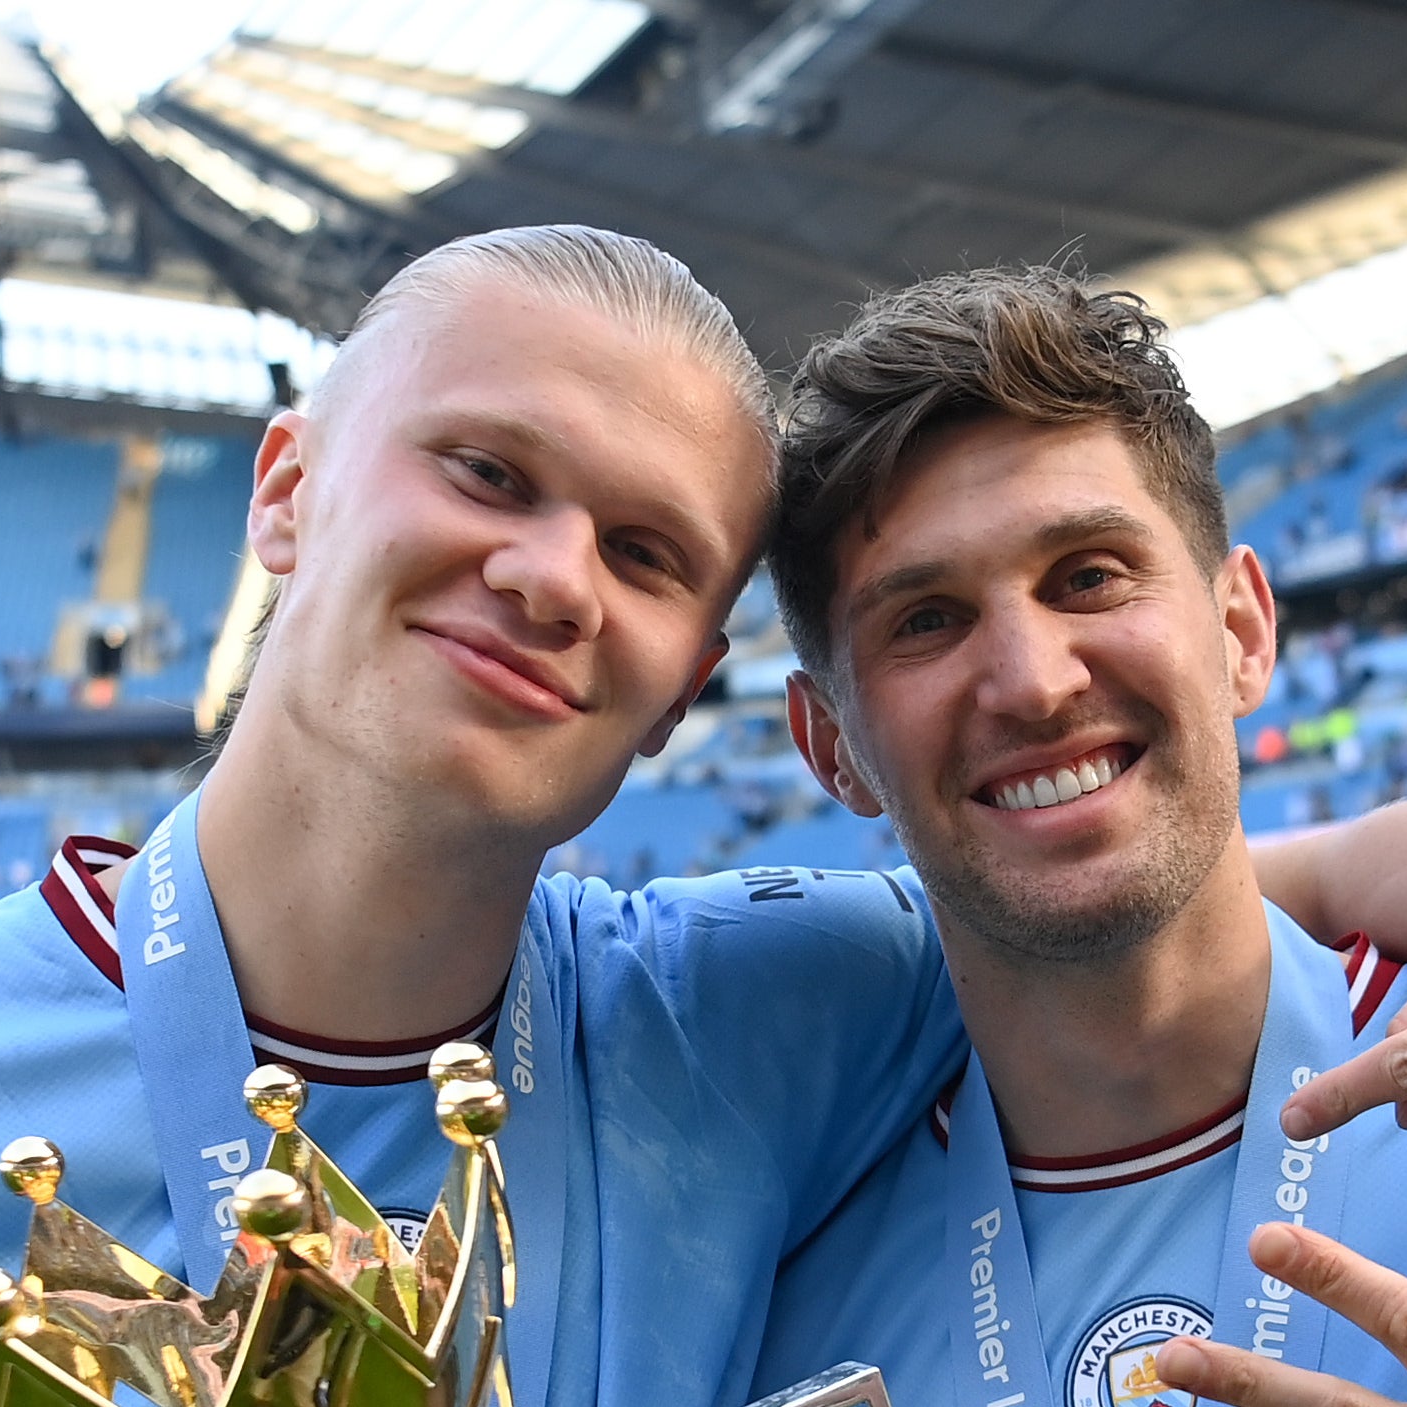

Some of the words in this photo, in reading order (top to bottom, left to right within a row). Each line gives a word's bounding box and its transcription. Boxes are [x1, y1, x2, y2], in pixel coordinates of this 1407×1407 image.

[140, 811, 186, 966] Premie
[969, 1207, 1010, 1384] Premier
[1080, 1310, 1206, 1378] MANCHESTE
